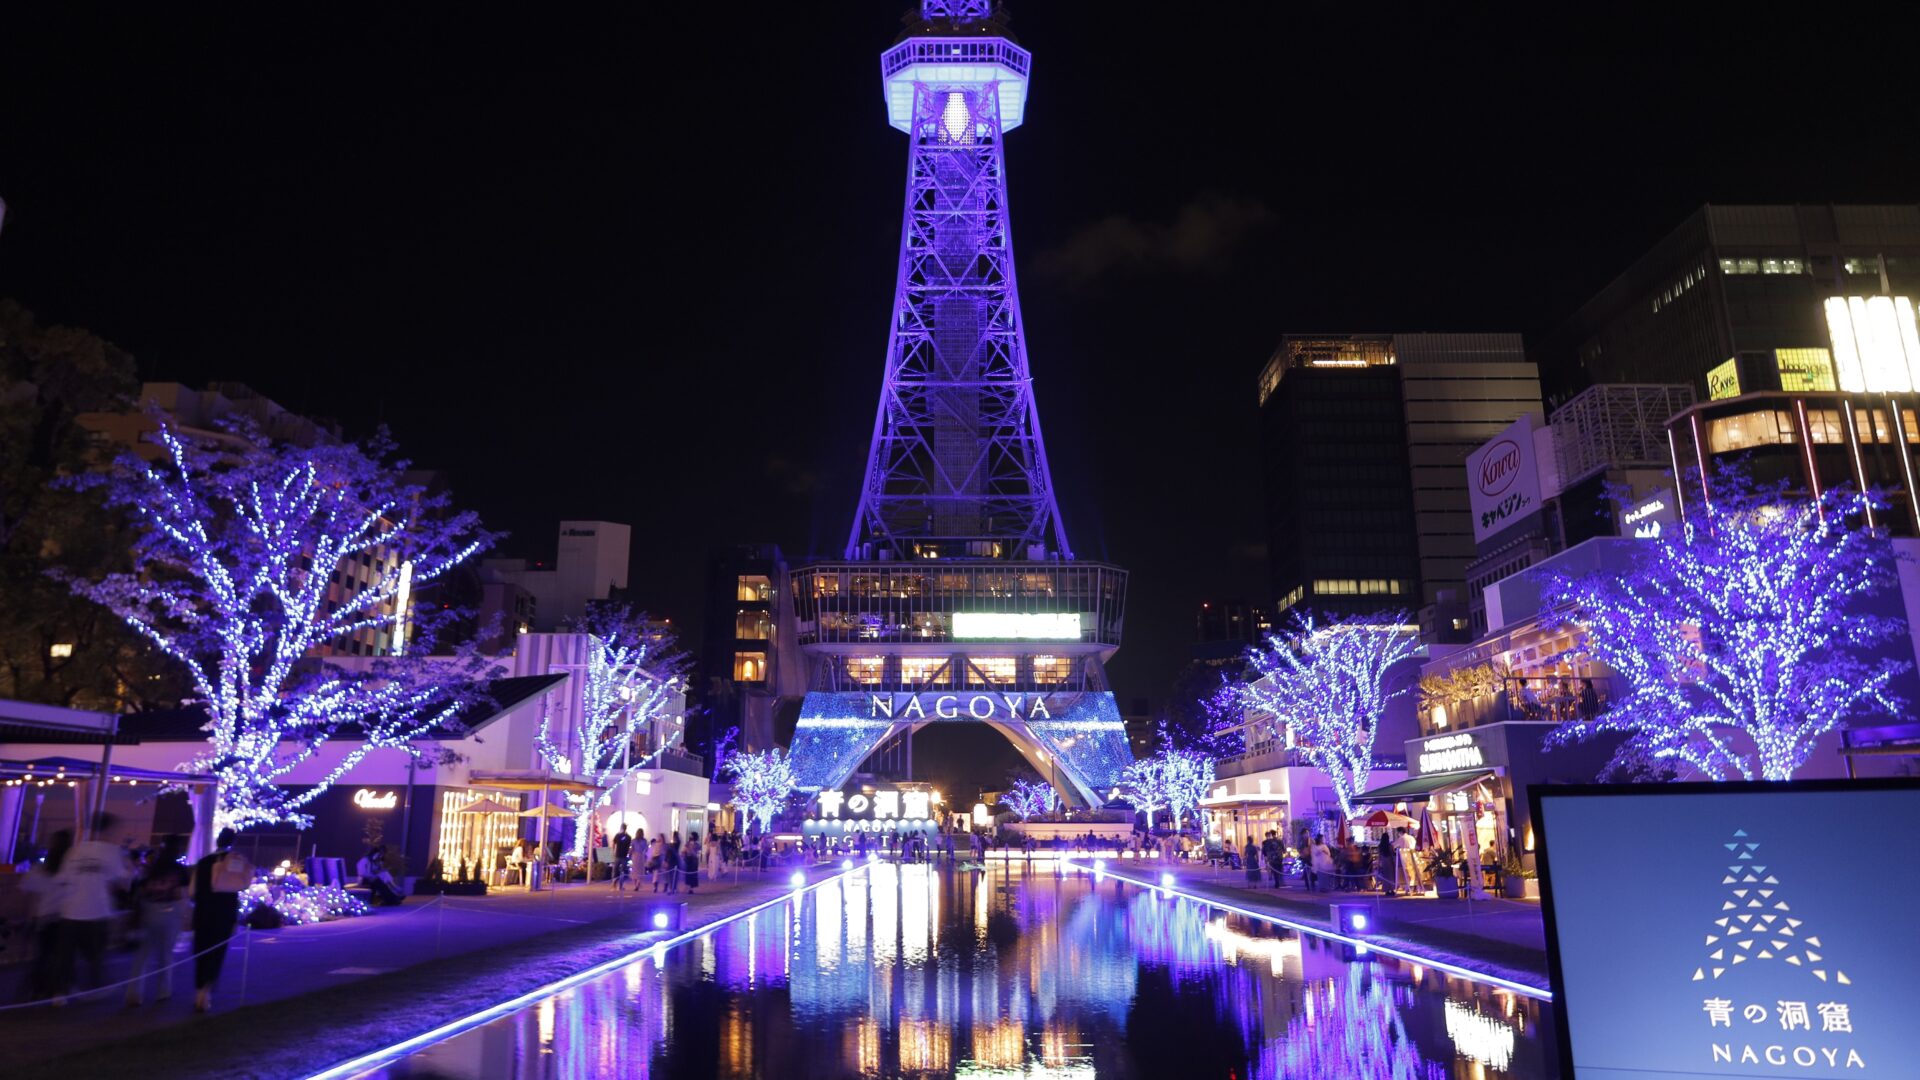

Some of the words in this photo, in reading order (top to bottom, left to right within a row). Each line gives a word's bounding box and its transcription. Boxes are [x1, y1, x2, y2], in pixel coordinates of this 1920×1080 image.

[1482, 448, 1518, 489] Kowa
[871, 695, 1051, 719] NAGOYA
[1703, 997, 1852, 1033] 青の洞窟
[1711, 1043, 1865, 1069] NAGOYA
